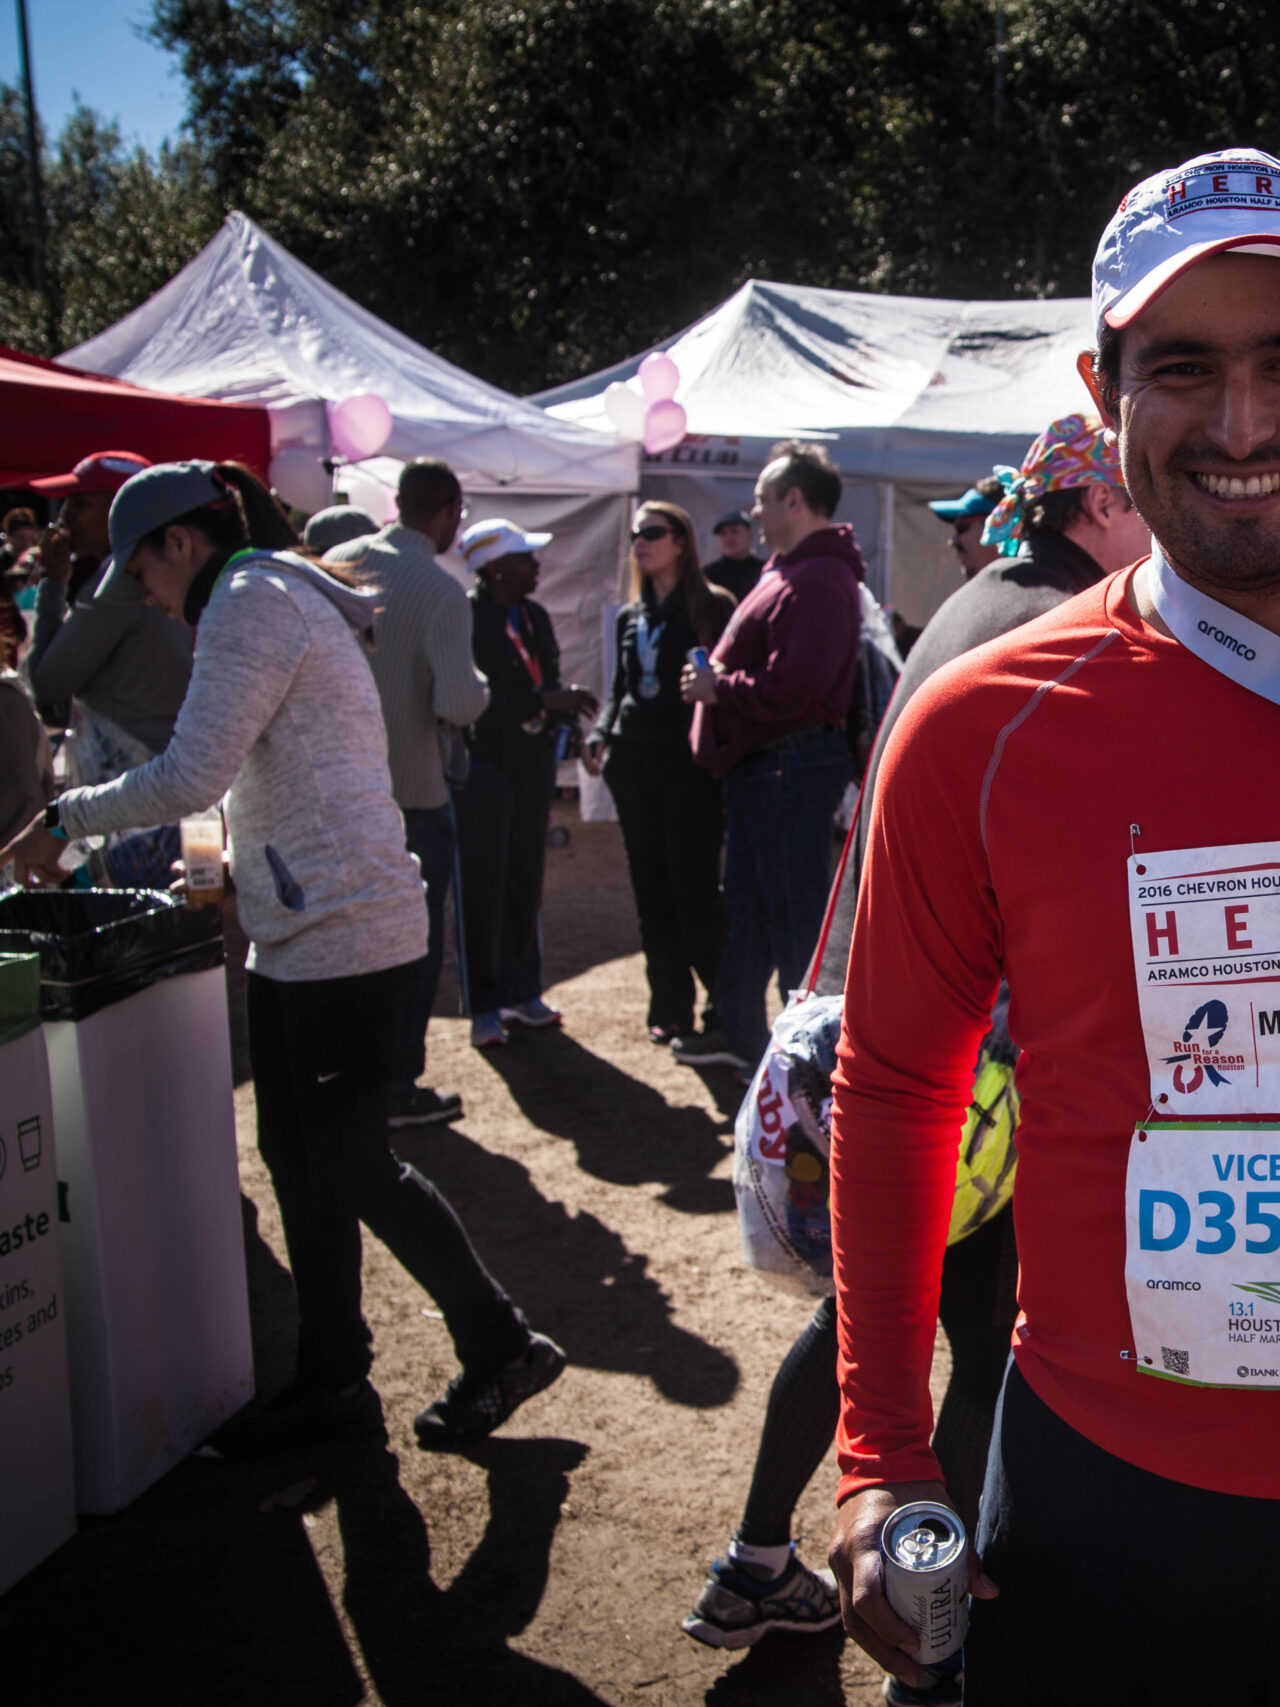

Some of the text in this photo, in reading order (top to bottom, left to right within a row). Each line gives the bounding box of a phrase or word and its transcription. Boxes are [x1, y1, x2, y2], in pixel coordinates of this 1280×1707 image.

[1167, 199, 1203, 217] ARAMCO
[1206, 196, 1247, 205] HOUSTON
[1250, 197, 1272, 206] HALF
[1198, 619, 1257, 662] aramco
[1138, 883, 1173, 899] 2016
[1177, 879, 1247, 896] CHEVRON
[1147, 965, 1209, 982] ARAMCO
[1213, 960, 1280, 977] HOUSTON
[1173, 1041, 1201, 1053] Run
[1193, 1054, 1245, 1065] Reason
[1146, 1279, 1202, 1292] aramco
[27, 1294, 57, 1334] and
[1228, 1302, 1254, 1317] 13.1
[1228, 1333, 1257, 1344] HALF
[1250, 1368, 1279, 1378] BANK
[930, 1578, 952, 1649] ULTRA
